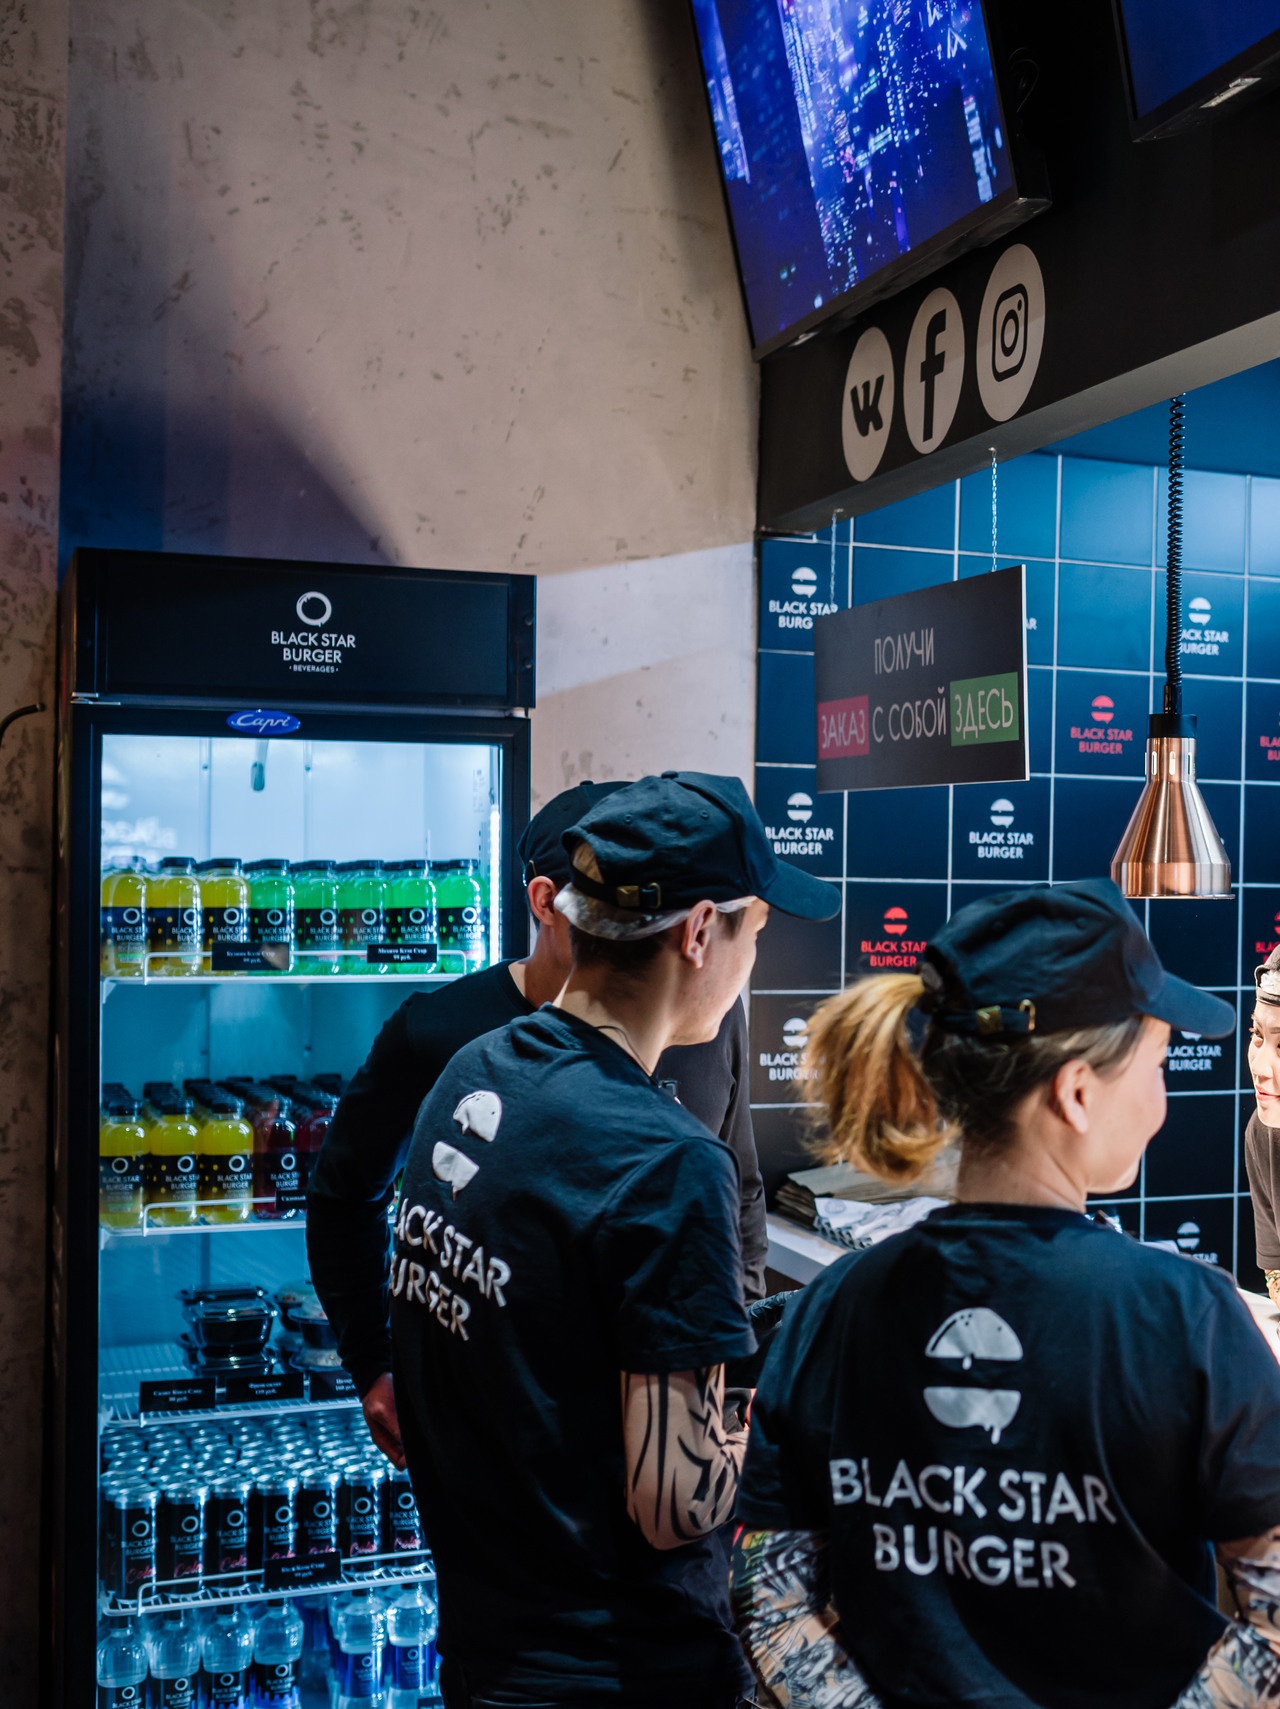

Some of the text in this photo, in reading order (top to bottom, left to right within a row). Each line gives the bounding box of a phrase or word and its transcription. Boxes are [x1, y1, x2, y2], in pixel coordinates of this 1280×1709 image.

[769, 600, 807, 614] BLACK
[778, 615, 814, 629] BURG
[271, 630, 356, 648] BLACK STAR
[1180, 628, 1229, 642] ACK STAR
[283, 648, 342, 663] BURGER
[874, 627, 934, 675] ПОЛУЧИ
[236, 714, 290, 733] Capri
[821, 709, 866, 750] ЗАКАЗ
[888, 686, 946, 741] СОБОЙ
[954, 688, 1014, 740] ЗДЕСЬ
[1070, 727, 1133, 741] BLACK STAR
[1079, 741, 1123, 754] BURGER
[765, 826, 834, 841] BLACK STAR
[969, 831, 1034, 845] BLACK STAR
[774, 841, 823, 855] BURGER
[977, 846, 1024, 859] BURGER
[861, 940, 927, 953] BLACK STAR
[870, 955, 917, 967] BURGER
[1196, 1044, 1222, 1057] STAR
[759, 1053, 798, 1066] BLACK
[1169, 1059, 1213, 1071] BURGER
[393, 1198, 512, 1307] ACK STAR
[389, 1251, 471, 1341] URGER
[829, 1457, 1117, 1525] BLACK STAR
[872, 1523, 1077, 1589] BURGER
